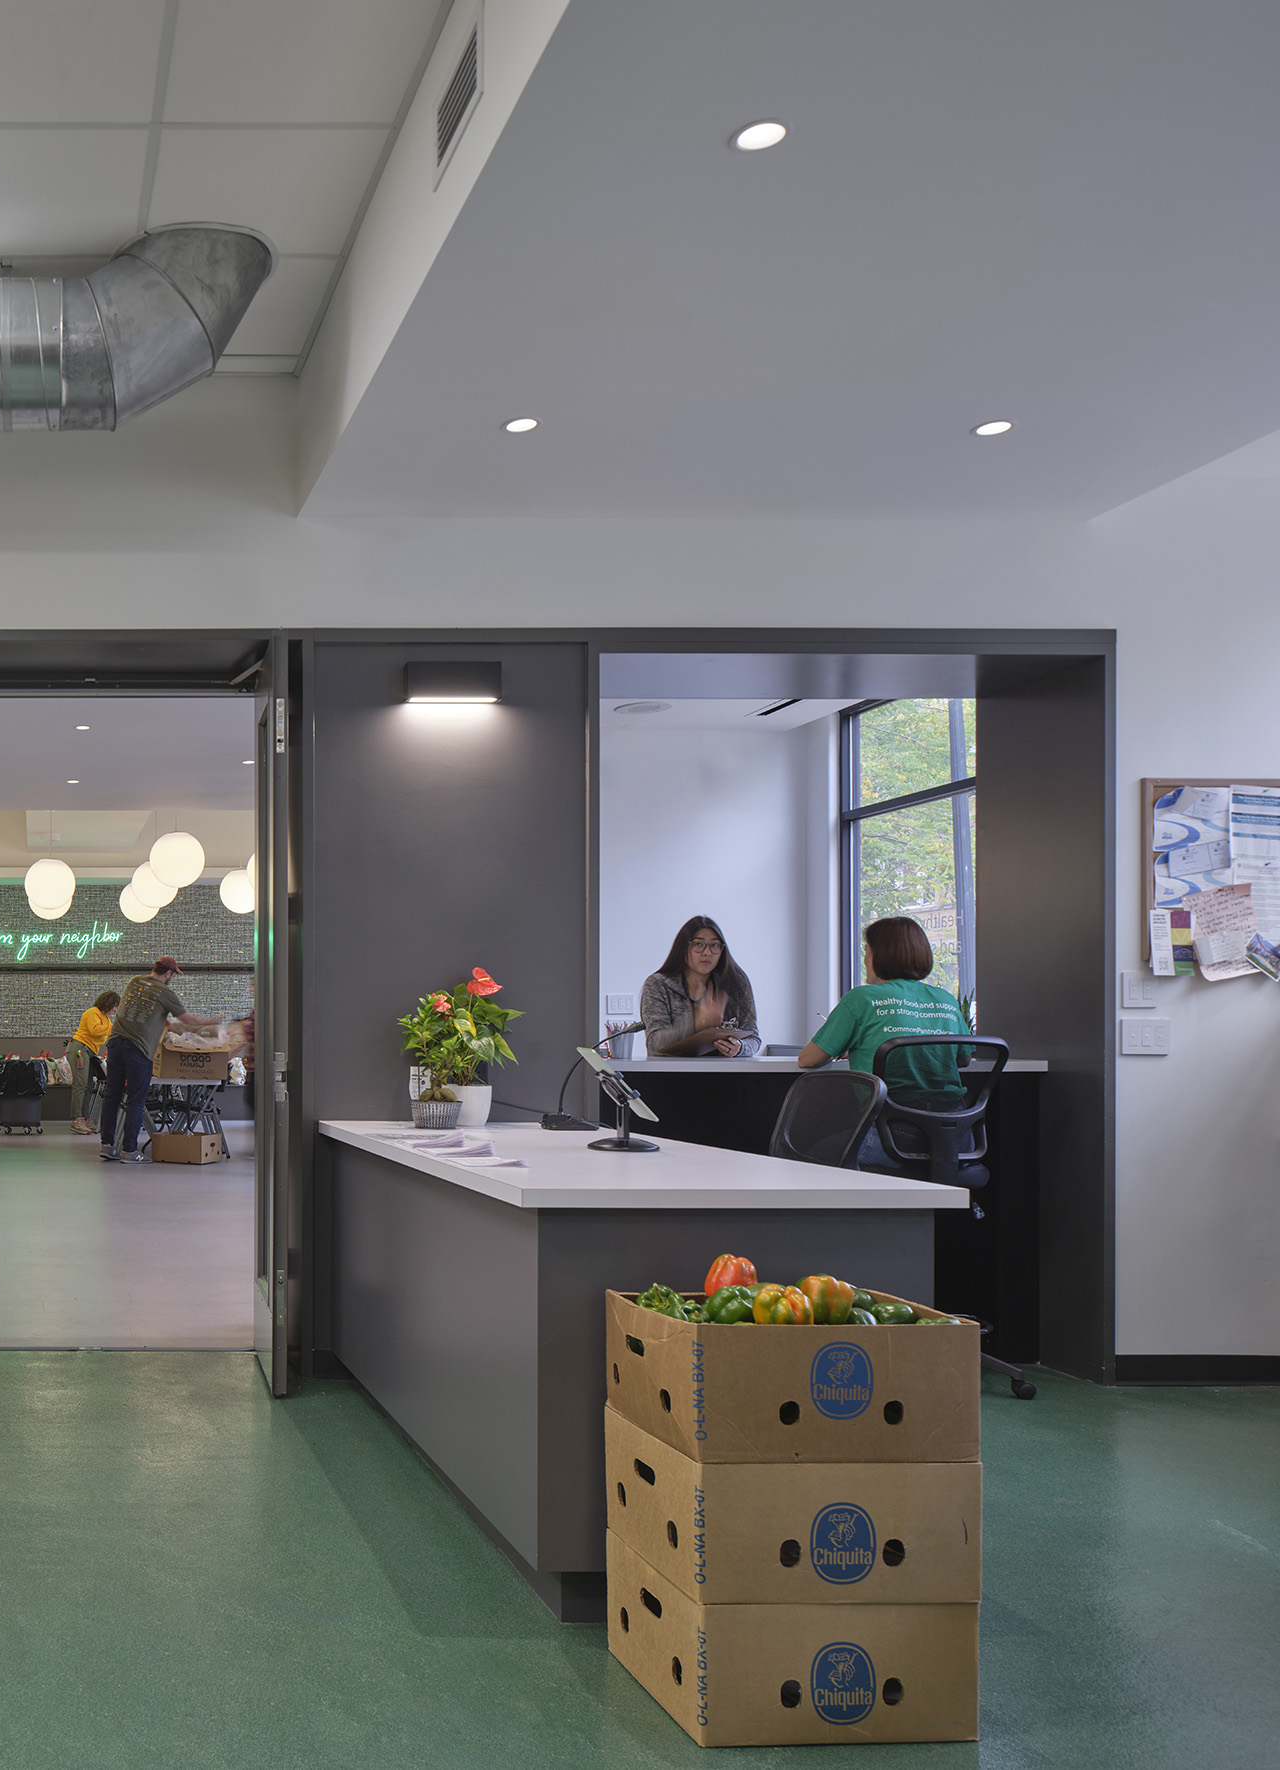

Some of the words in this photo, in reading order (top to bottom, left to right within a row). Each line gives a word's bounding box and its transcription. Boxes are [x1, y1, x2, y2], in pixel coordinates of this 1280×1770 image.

[17, 932, 54, 960] your
[60, 920, 124, 959] neighbor
[872, 998, 902, 1006] Healthy
[904, 999, 918, 1008] food
[896, 1008, 918, 1018] strong
[180, 1054, 212, 1068] braga
[692, 1340, 705, 1383] BX-07
[814, 1382, 870, 1406] Chiquita
[694, 1485, 706, 1528] BX-07
[813, 1548, 873, 1570] Chiquita
[814, 1688, 873, 1712] Chiquita
